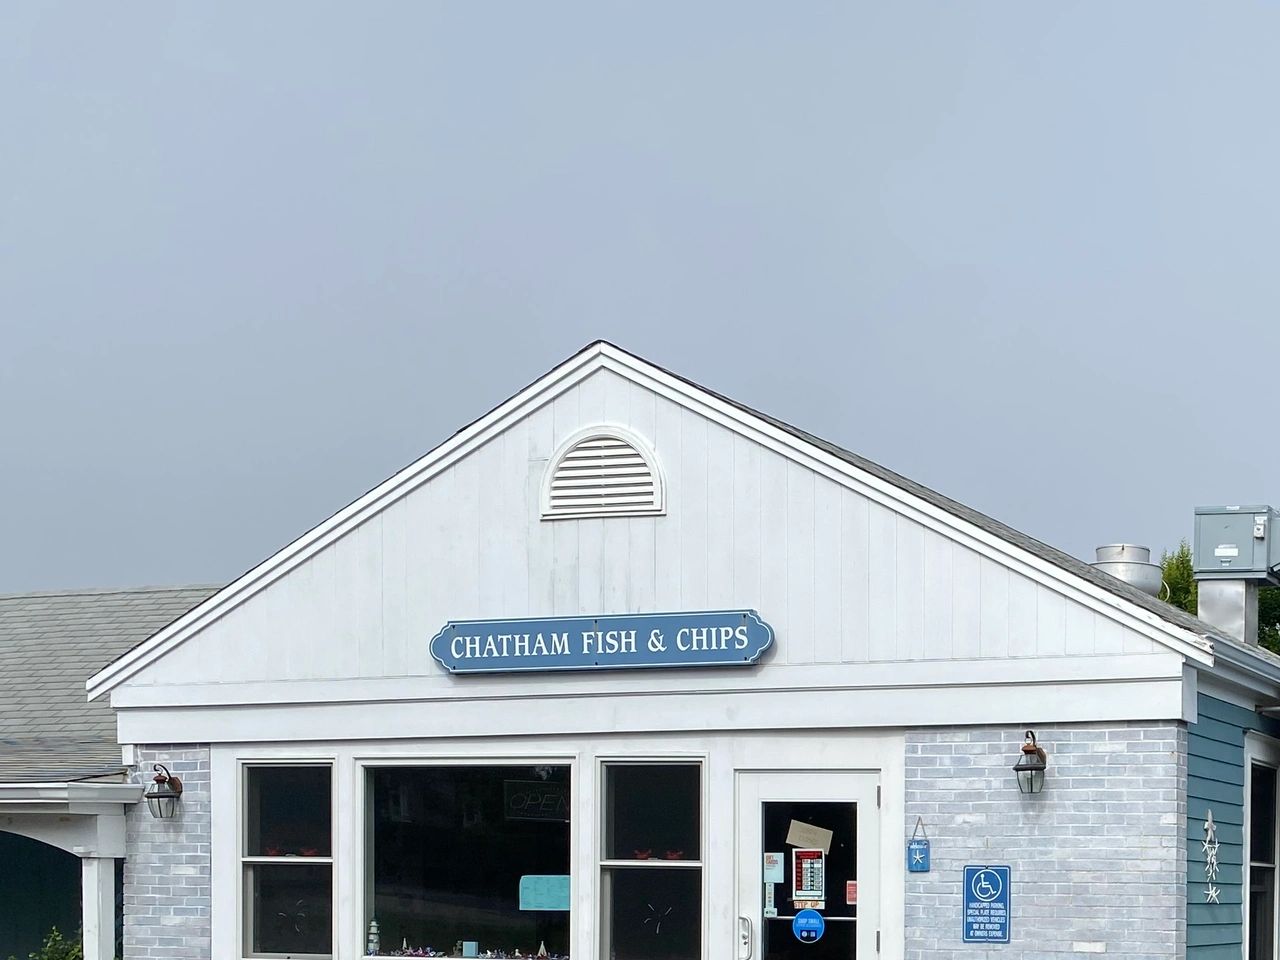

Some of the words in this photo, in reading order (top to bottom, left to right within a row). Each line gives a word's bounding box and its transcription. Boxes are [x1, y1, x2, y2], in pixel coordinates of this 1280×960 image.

[451, 632, 570, 659] CHATHAM
[582, 629, 637, 655] FISH
[647, 629, 668, 653] &
[676, 626, 749, 651] CHIPS
